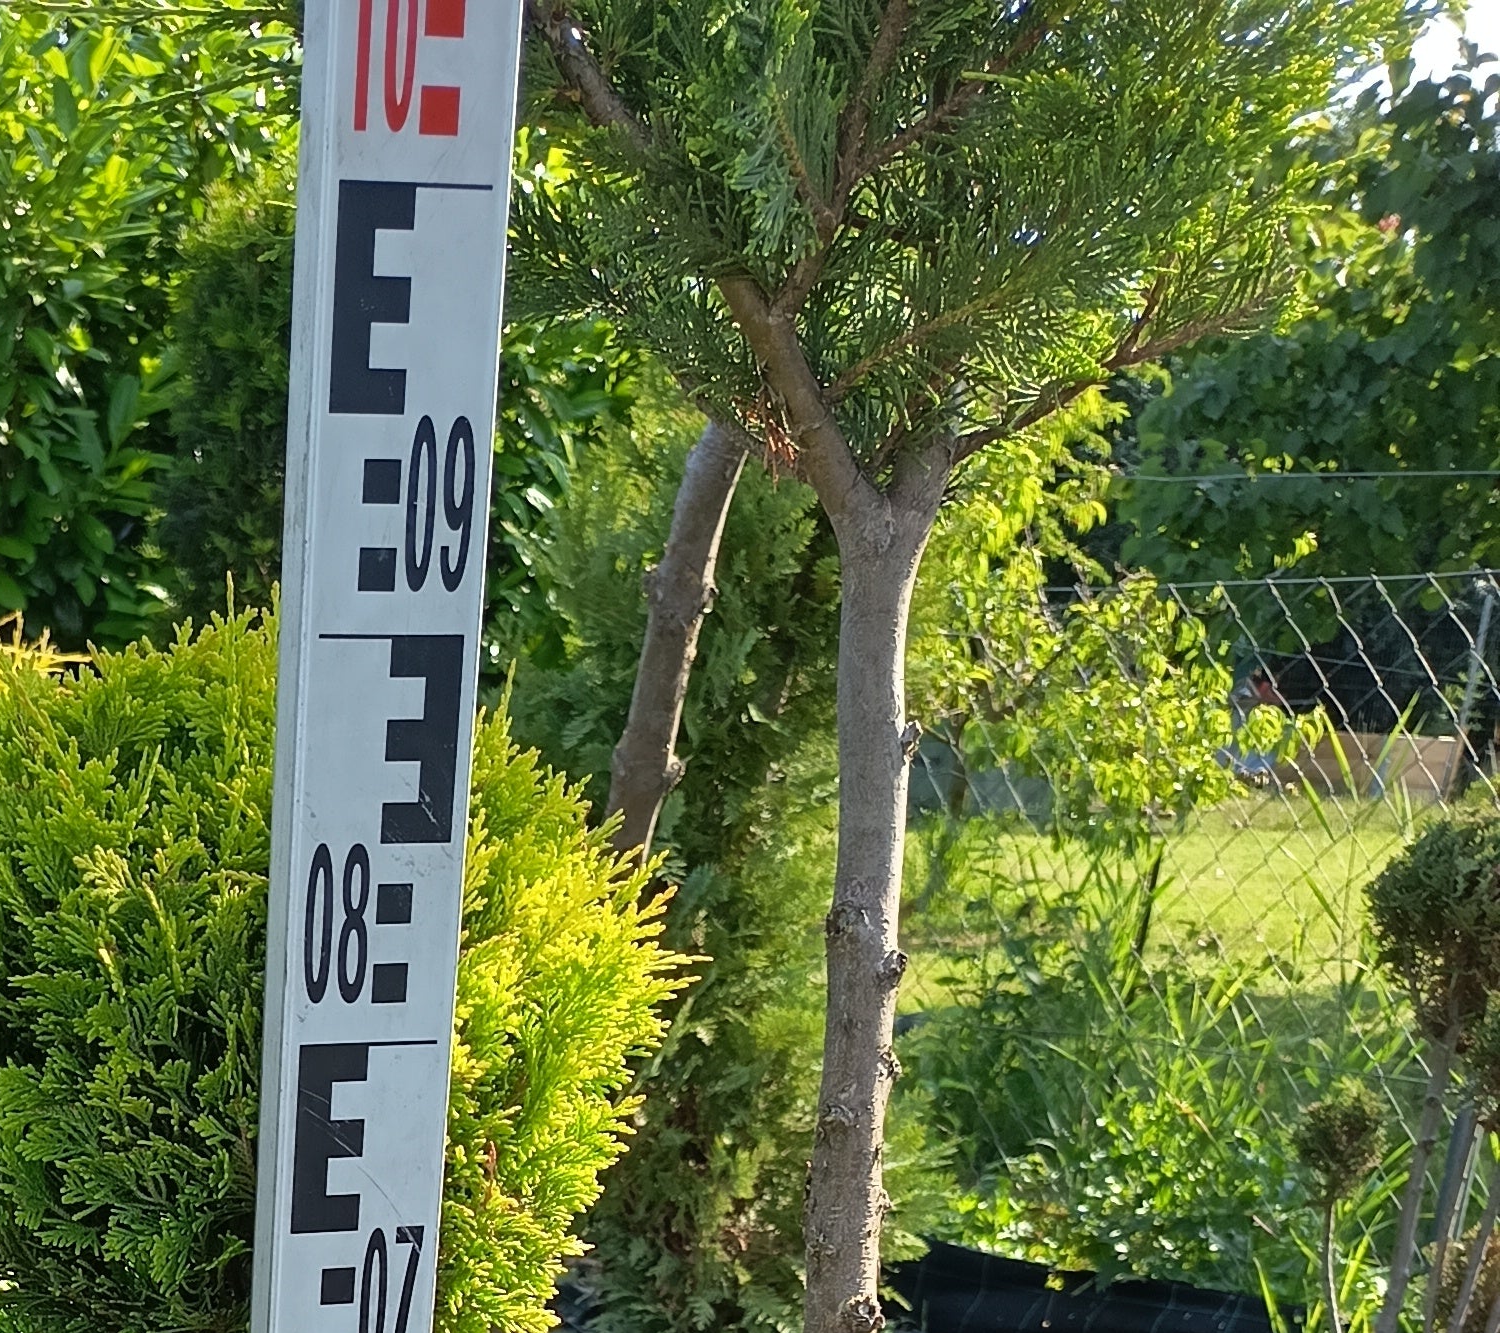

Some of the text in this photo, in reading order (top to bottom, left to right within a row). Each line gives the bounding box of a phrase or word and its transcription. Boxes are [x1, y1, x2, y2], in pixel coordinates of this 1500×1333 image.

[353, 0, 419, 132] 10
[404, 414, 475, 593] 09
[303, 842, 371, 1005] 08
